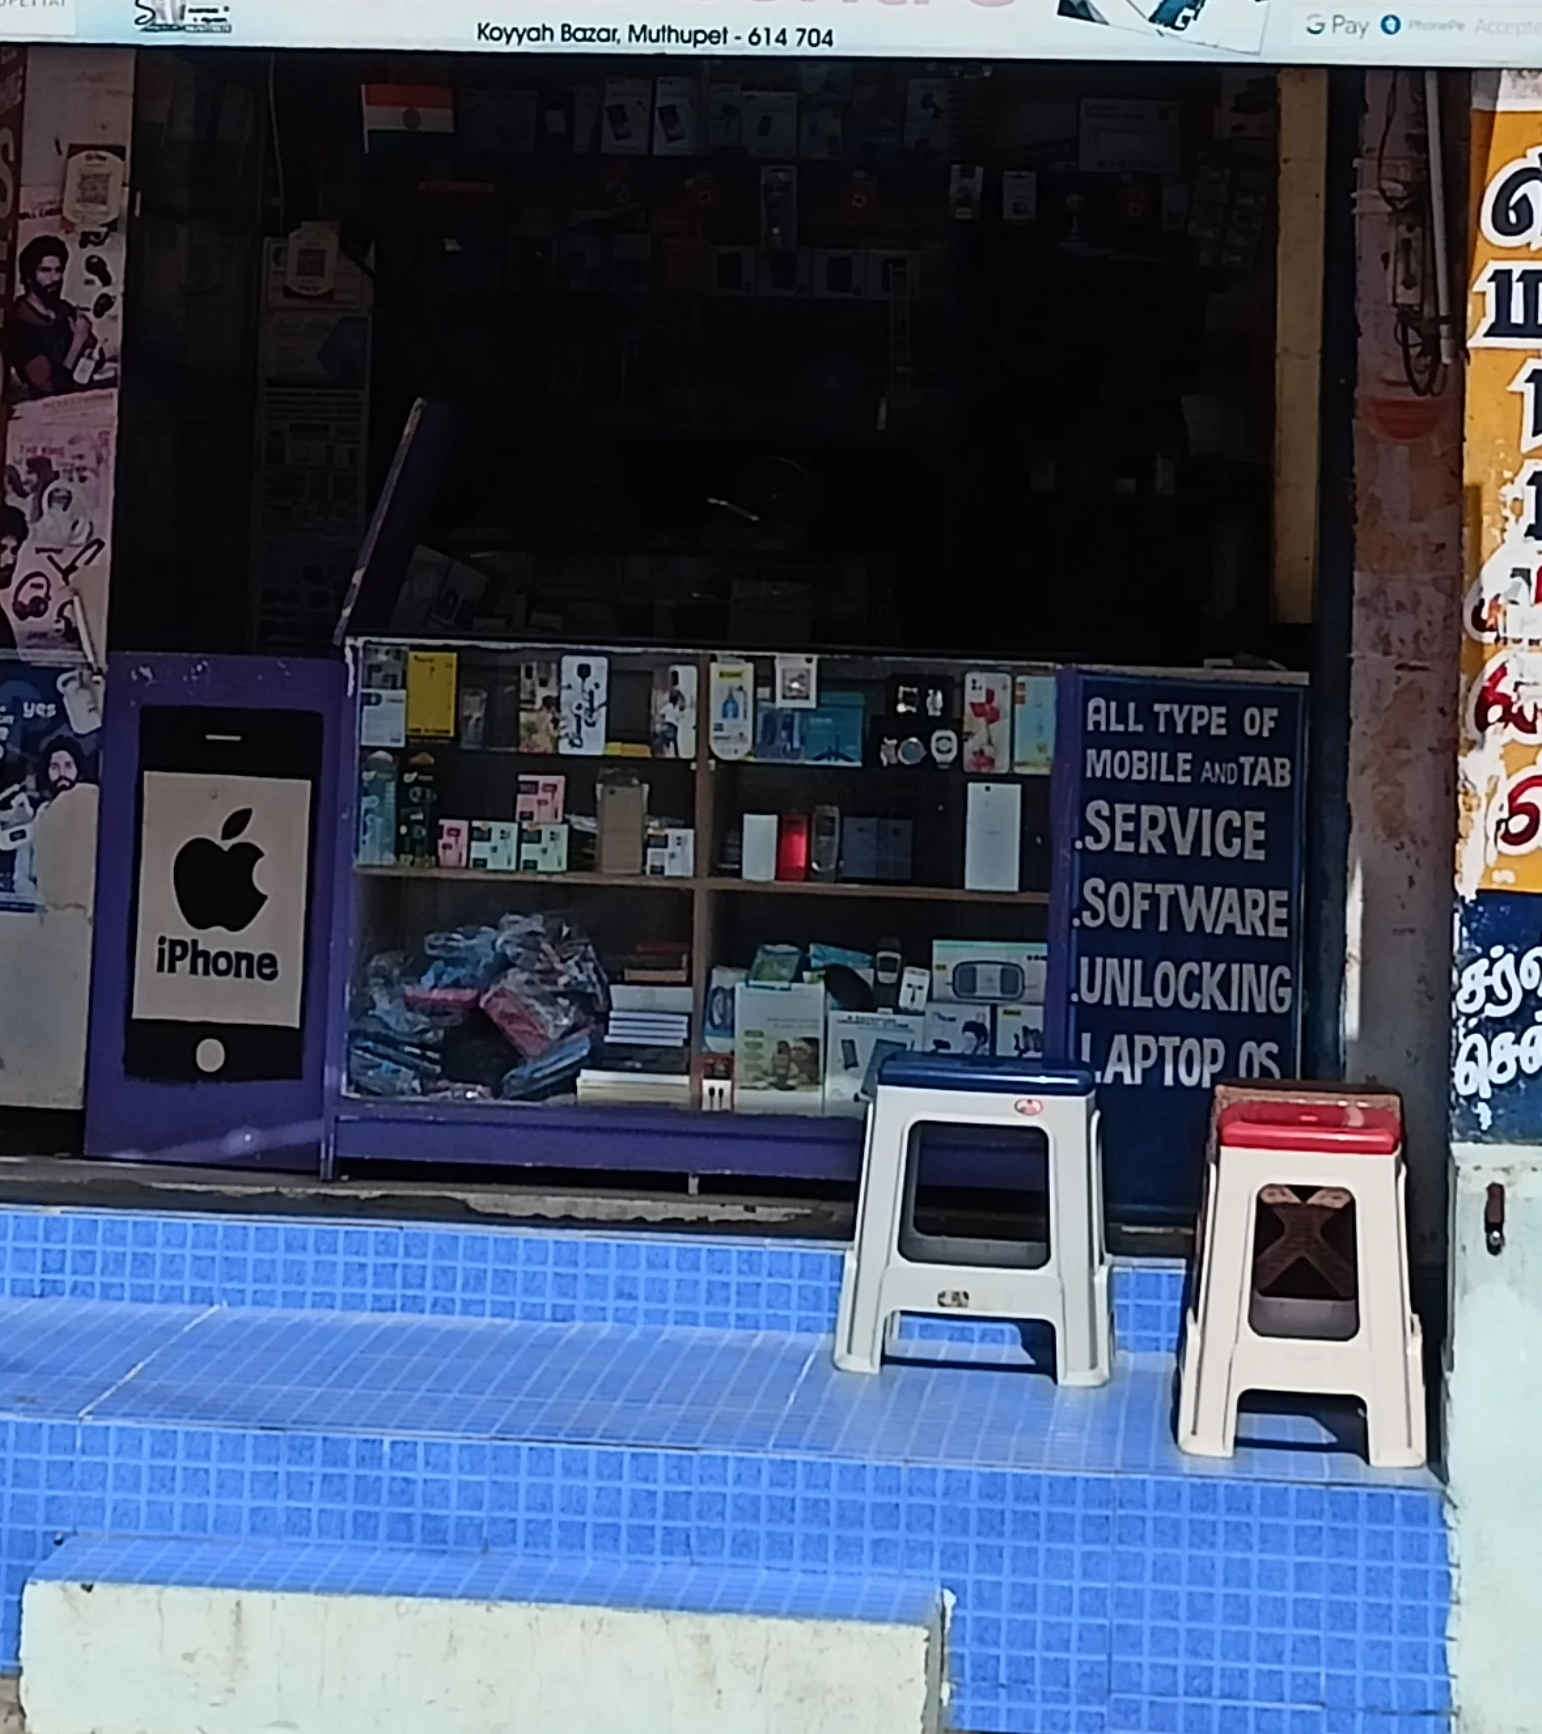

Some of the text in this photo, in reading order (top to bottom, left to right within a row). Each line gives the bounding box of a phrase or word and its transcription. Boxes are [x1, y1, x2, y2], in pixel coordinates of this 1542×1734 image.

[477, 21, 555, 46] Koyyah
[561, 22, 621, 46] Bazar,
[629, 23, 728, 49] Muthupet
[748, 26, 788, 47] 614
[794, 26, 834, 49] 704
[1332, 15, 1370, 39] Pay
[1087, 696, 1279, 737] ALL TYPE OF
[1085, 749, 1292, 788] MOBILE AND TAB
[155, 936, 279, 982] iPhone
